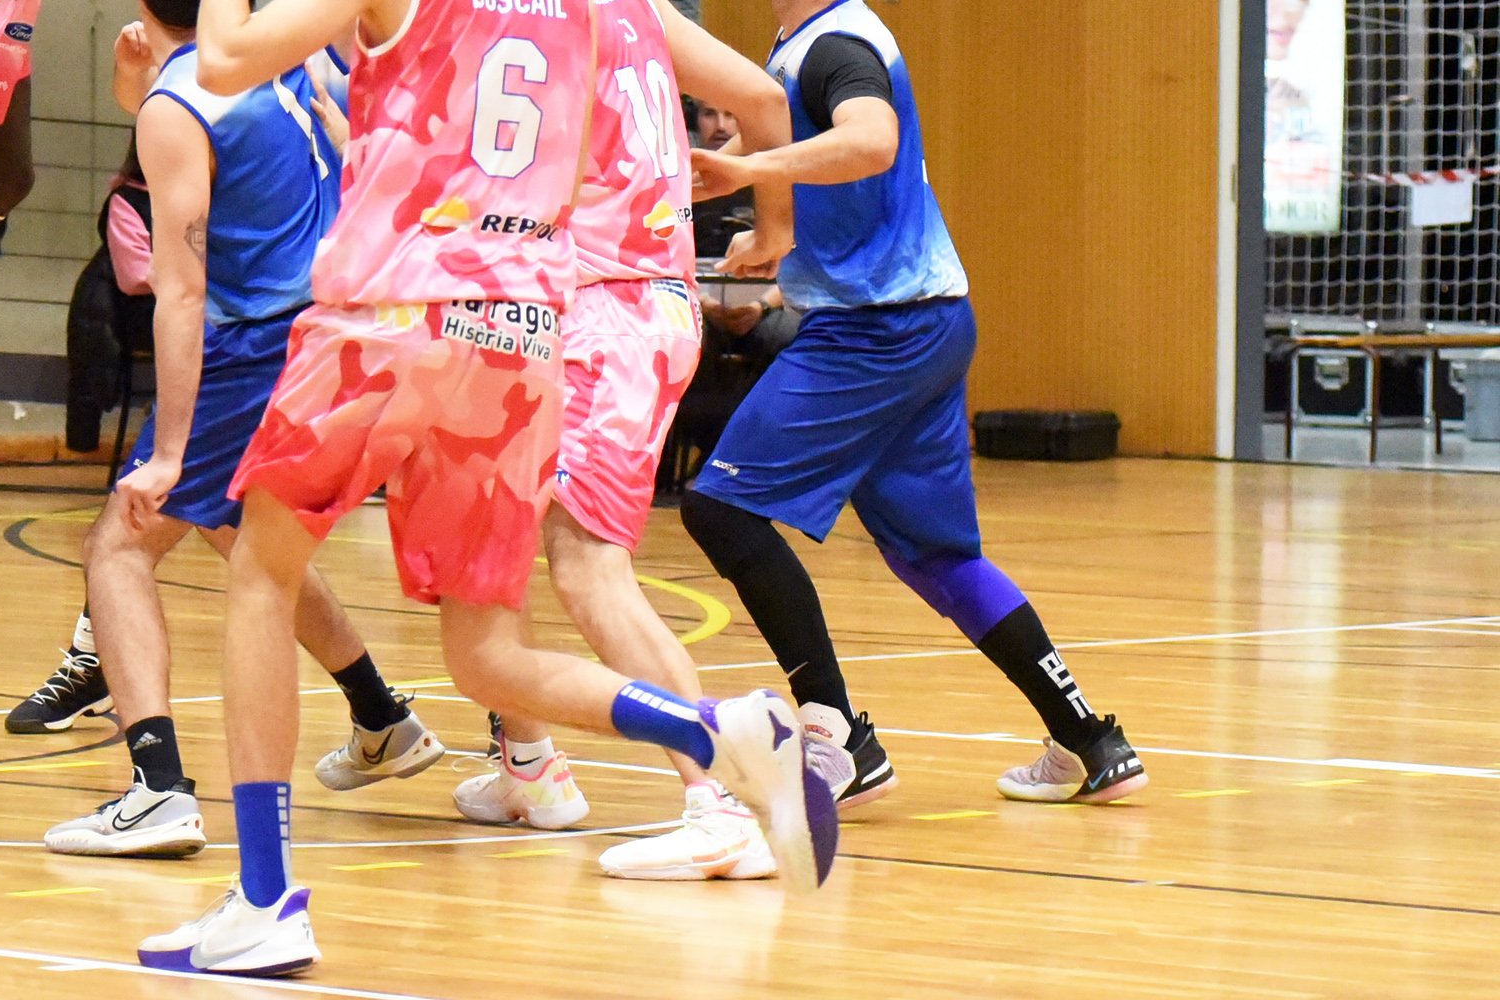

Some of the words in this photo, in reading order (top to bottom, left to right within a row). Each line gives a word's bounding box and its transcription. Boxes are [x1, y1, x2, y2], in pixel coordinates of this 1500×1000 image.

[470, 36, 549, 179] 6
[613, 58, 679, 180] 10
[522, 336, 551, 360] Viva
